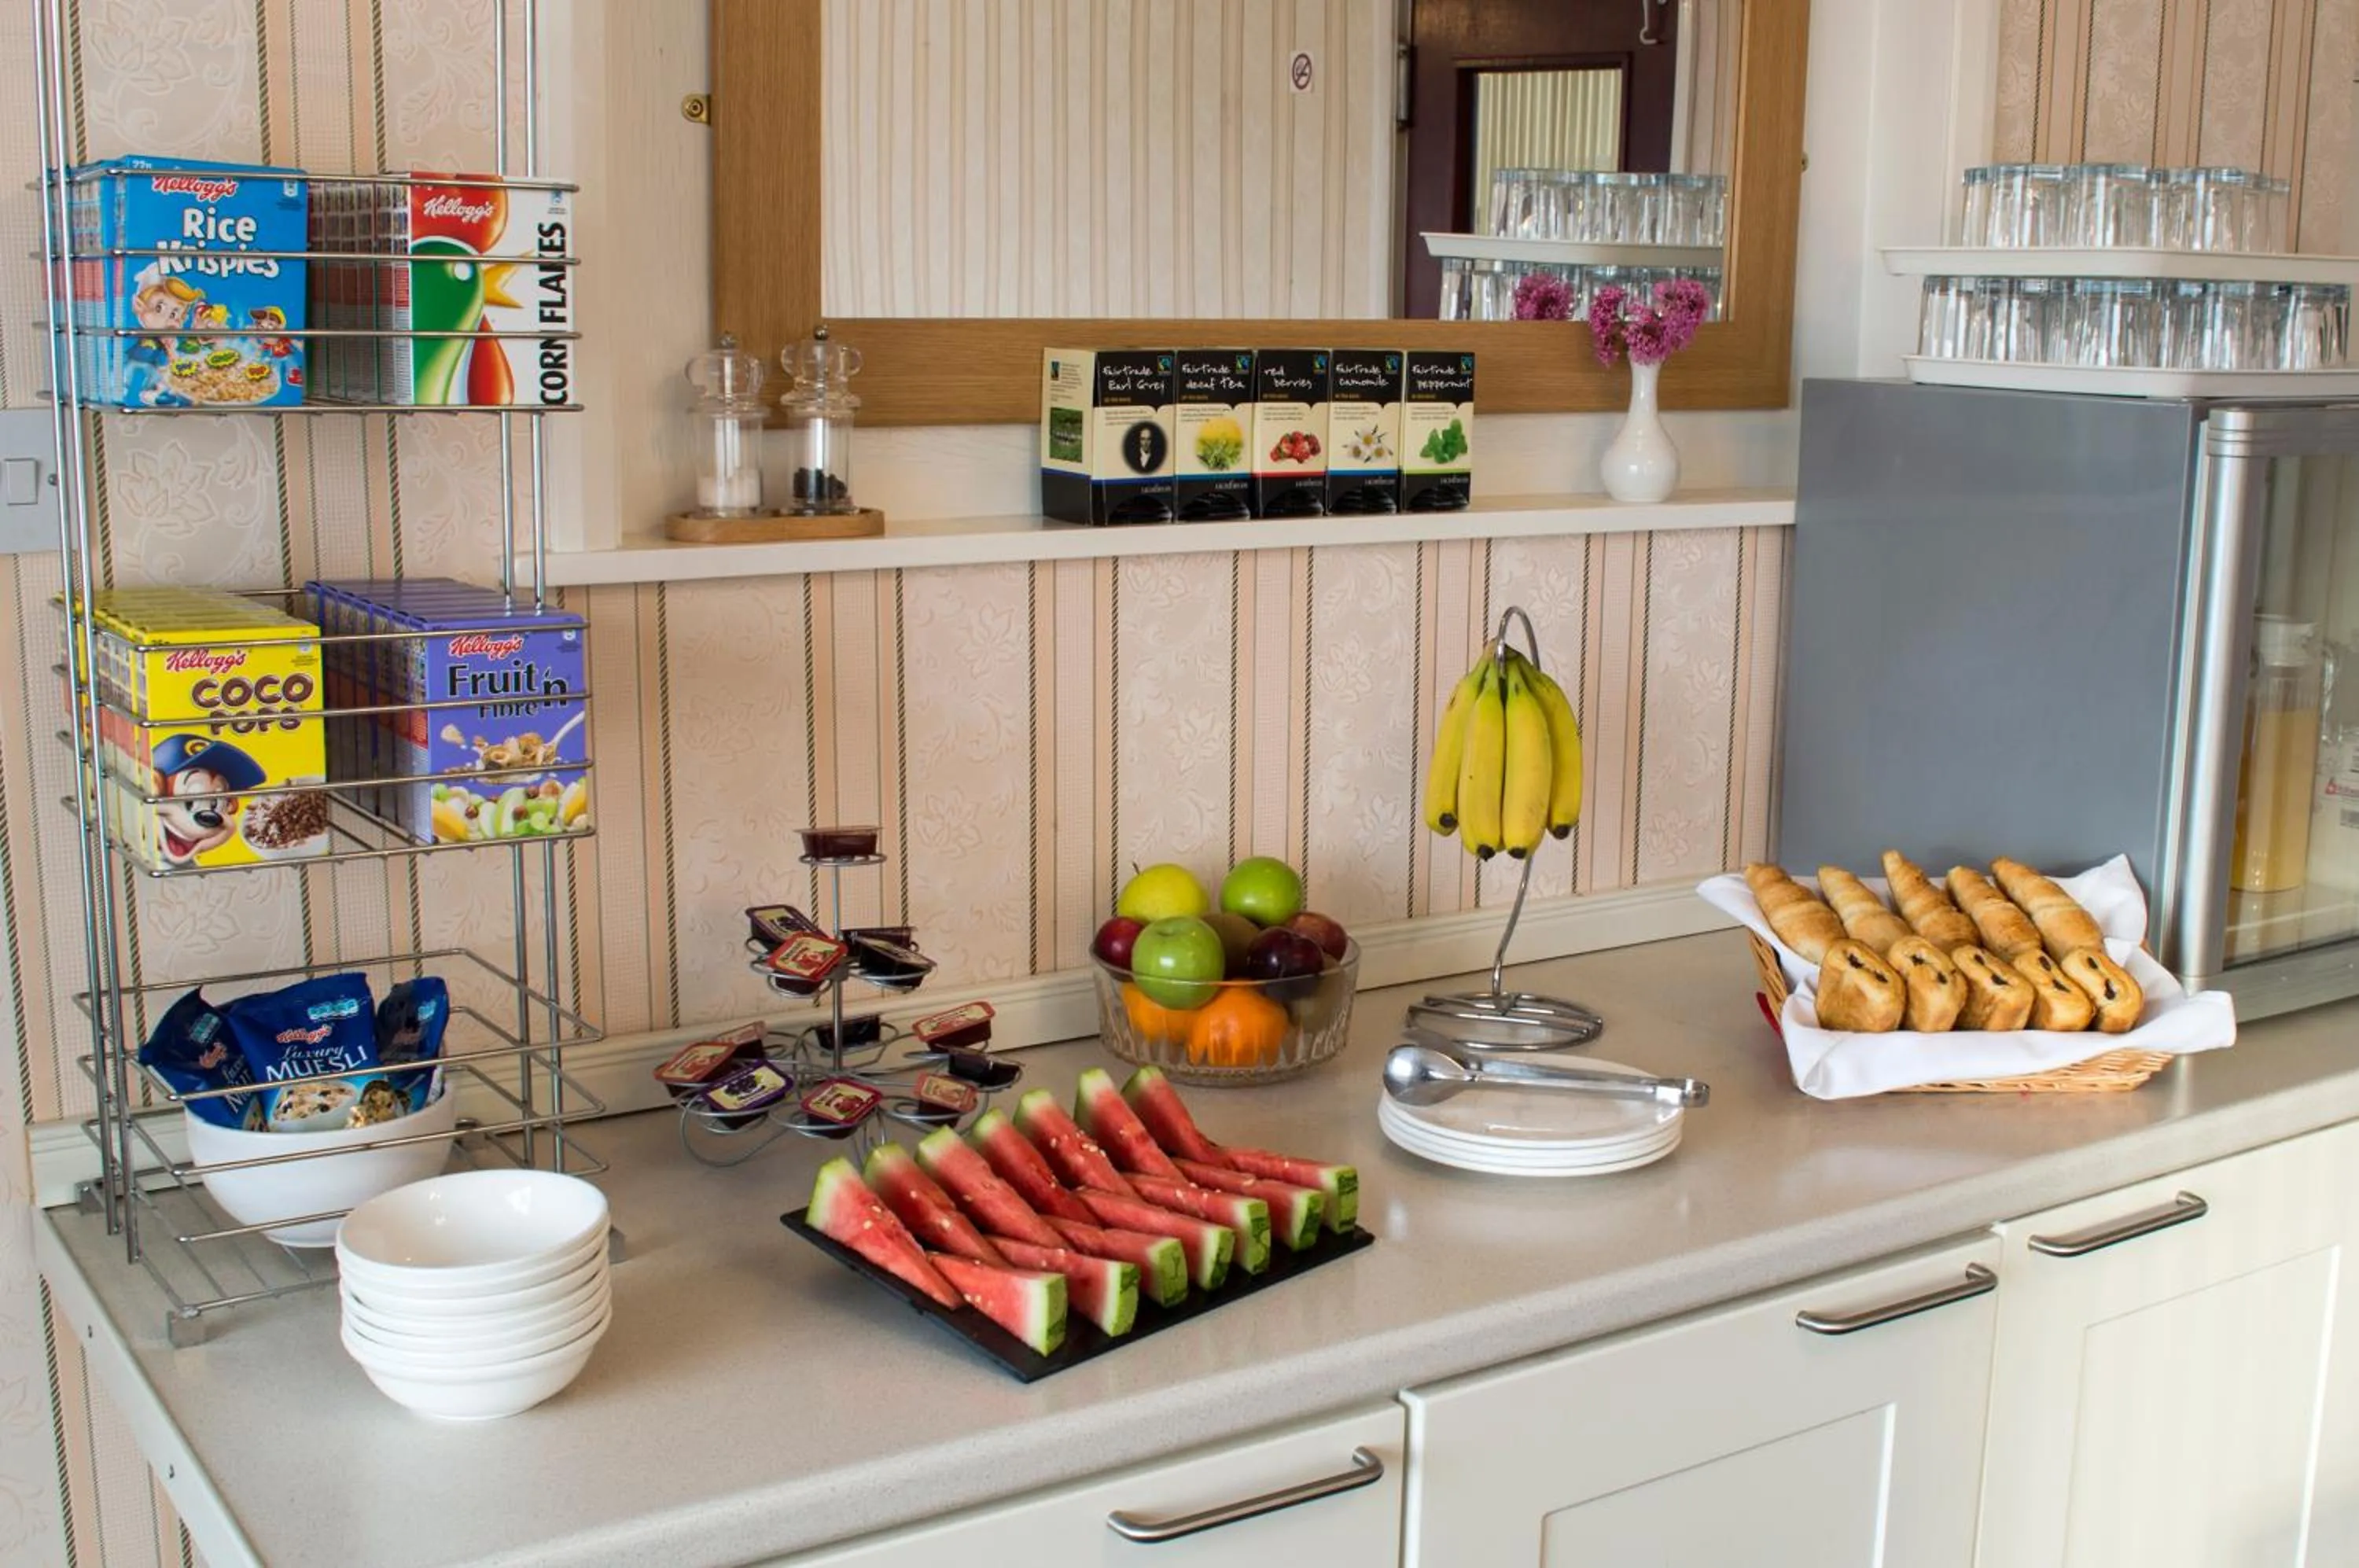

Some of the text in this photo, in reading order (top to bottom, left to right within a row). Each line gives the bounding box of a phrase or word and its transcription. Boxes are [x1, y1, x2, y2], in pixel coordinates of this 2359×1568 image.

[153, 176, 238, 202] Kellogg's
[182, 207, 257, 242] Rice
[423, 194, 495, 223] Kellogg's
[538, 222, 567, 323] FLAKES
[539, 330, 568, 405] CORN
[1108, 377, 1165, 396] Earl Grey
[166, 647, 248, 674] Kellogg's
[449, 634, 524, 661] Kellogg's
[191, 672, 315, 709] COCO
[447, 660, 538, 698] Fruit
[265, 1045, 368, 1082] MUESLI
[278, 1044, 344, 1061] Luxury
